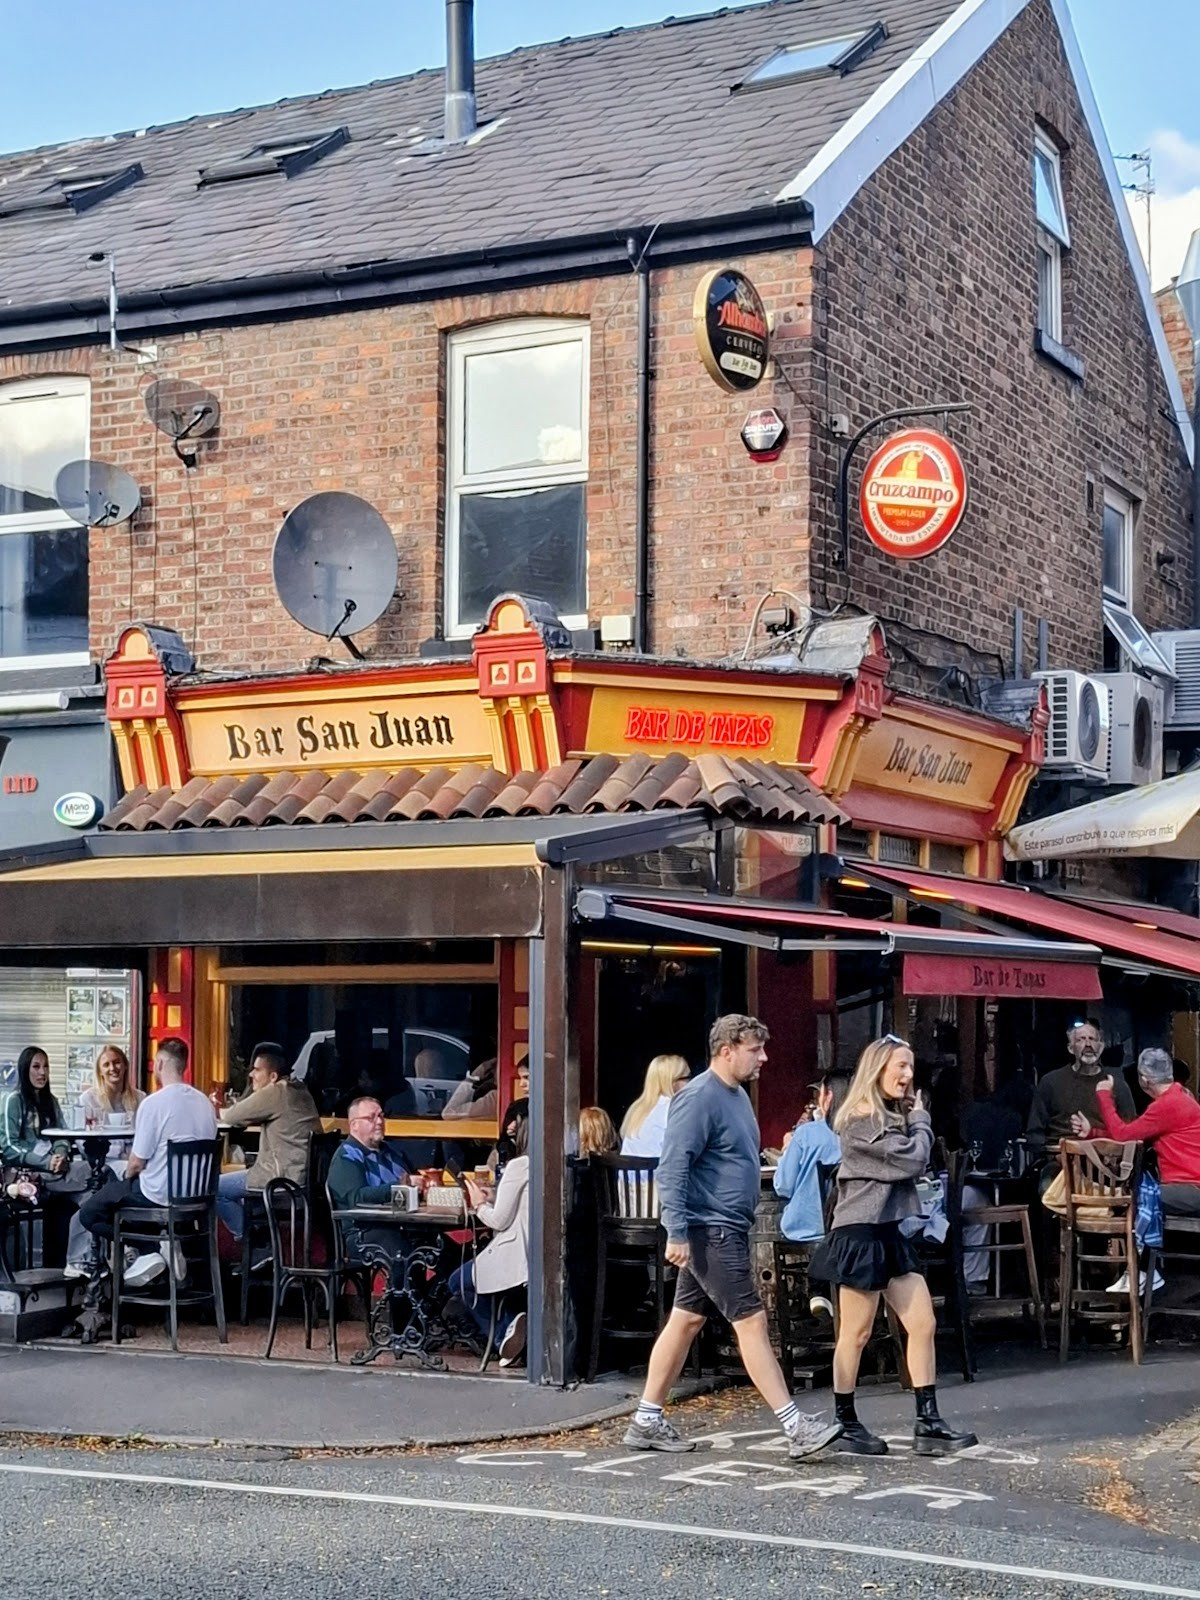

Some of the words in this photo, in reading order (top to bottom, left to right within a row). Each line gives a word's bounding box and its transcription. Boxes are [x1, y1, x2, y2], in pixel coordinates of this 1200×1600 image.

[869, 481, 954, 504] Cruzcampo
[906, 535, 917, 543] DE
[224, 724, 284, 761] Bar
[297, 715, 360, 761] San
[369, 710, 455, 749] Juan
[624, 707, 669, 741] BAR
[671, 711, 704, 743] DE
[707, 713, 773, 747] TAPAS
[883, 737, 917, 773] Bar
[908, 744, 942, 783] San
[937, 750, 972, 785] Juan
[1024, 839, 1039, 850] Este
[1040, 835, 1065, 849] parasol
[1109, 829, 1125, 839] que
[1127, 826, 1157, 840] respires
[973, 965, 995, 987] Bar
[998, 966, 1010, 987] de
[1013, 967, 1046, 989] Tapas
[455, 1450, 997, 1509] CLEAR
